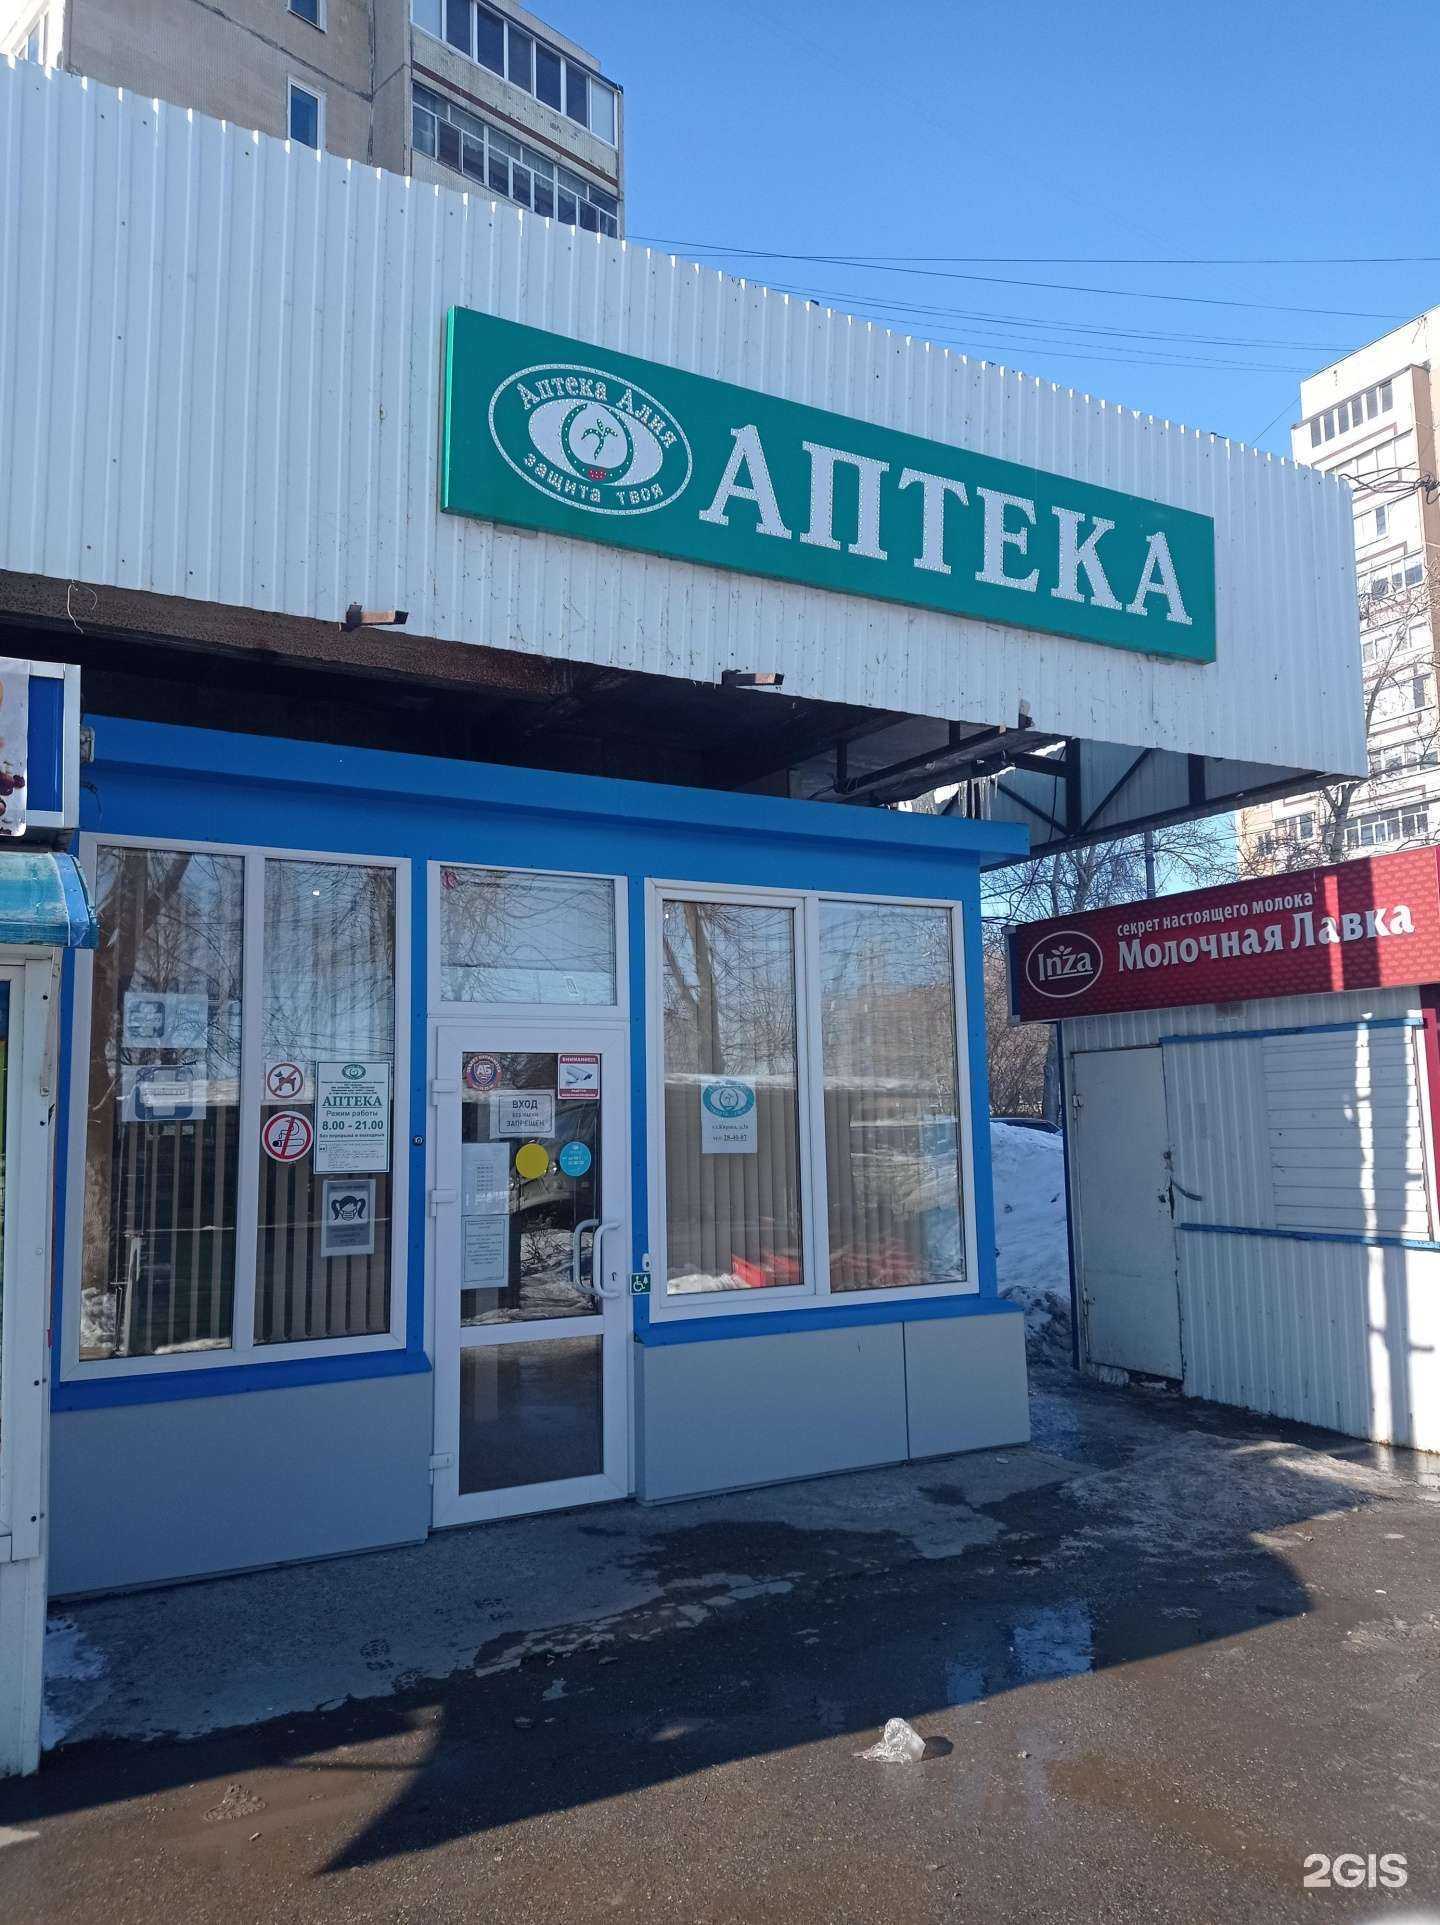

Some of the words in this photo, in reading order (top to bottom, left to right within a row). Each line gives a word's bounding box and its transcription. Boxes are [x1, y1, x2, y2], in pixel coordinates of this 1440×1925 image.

[516, 376, 608, 410] Аптека
[616, 388, 677, 448] Алия
[523, 453, 601, 503] защита
[616, 483, 664, 505] твоя
[699, 423, 1193, 626] АПТЕКА
[1117, 919, 1160, 938] секрет
[1163, 903, 1248, 929] настоящего
[1252, 890, 1314, 915] молока
[1118, 924, 1283, 972] Молочная
[1290, 904, 1416, 949] Лавка
[322, 1096, 382, 1106] АПТЕКА
[322, 1120, 345, 1130] 8.00
[355, 1120, 384, 1130] 21.00
[506, 1119, 545, 1127] ЗАПРЕЩЕН
[512, 1100, 538, 1109] ВХОД
